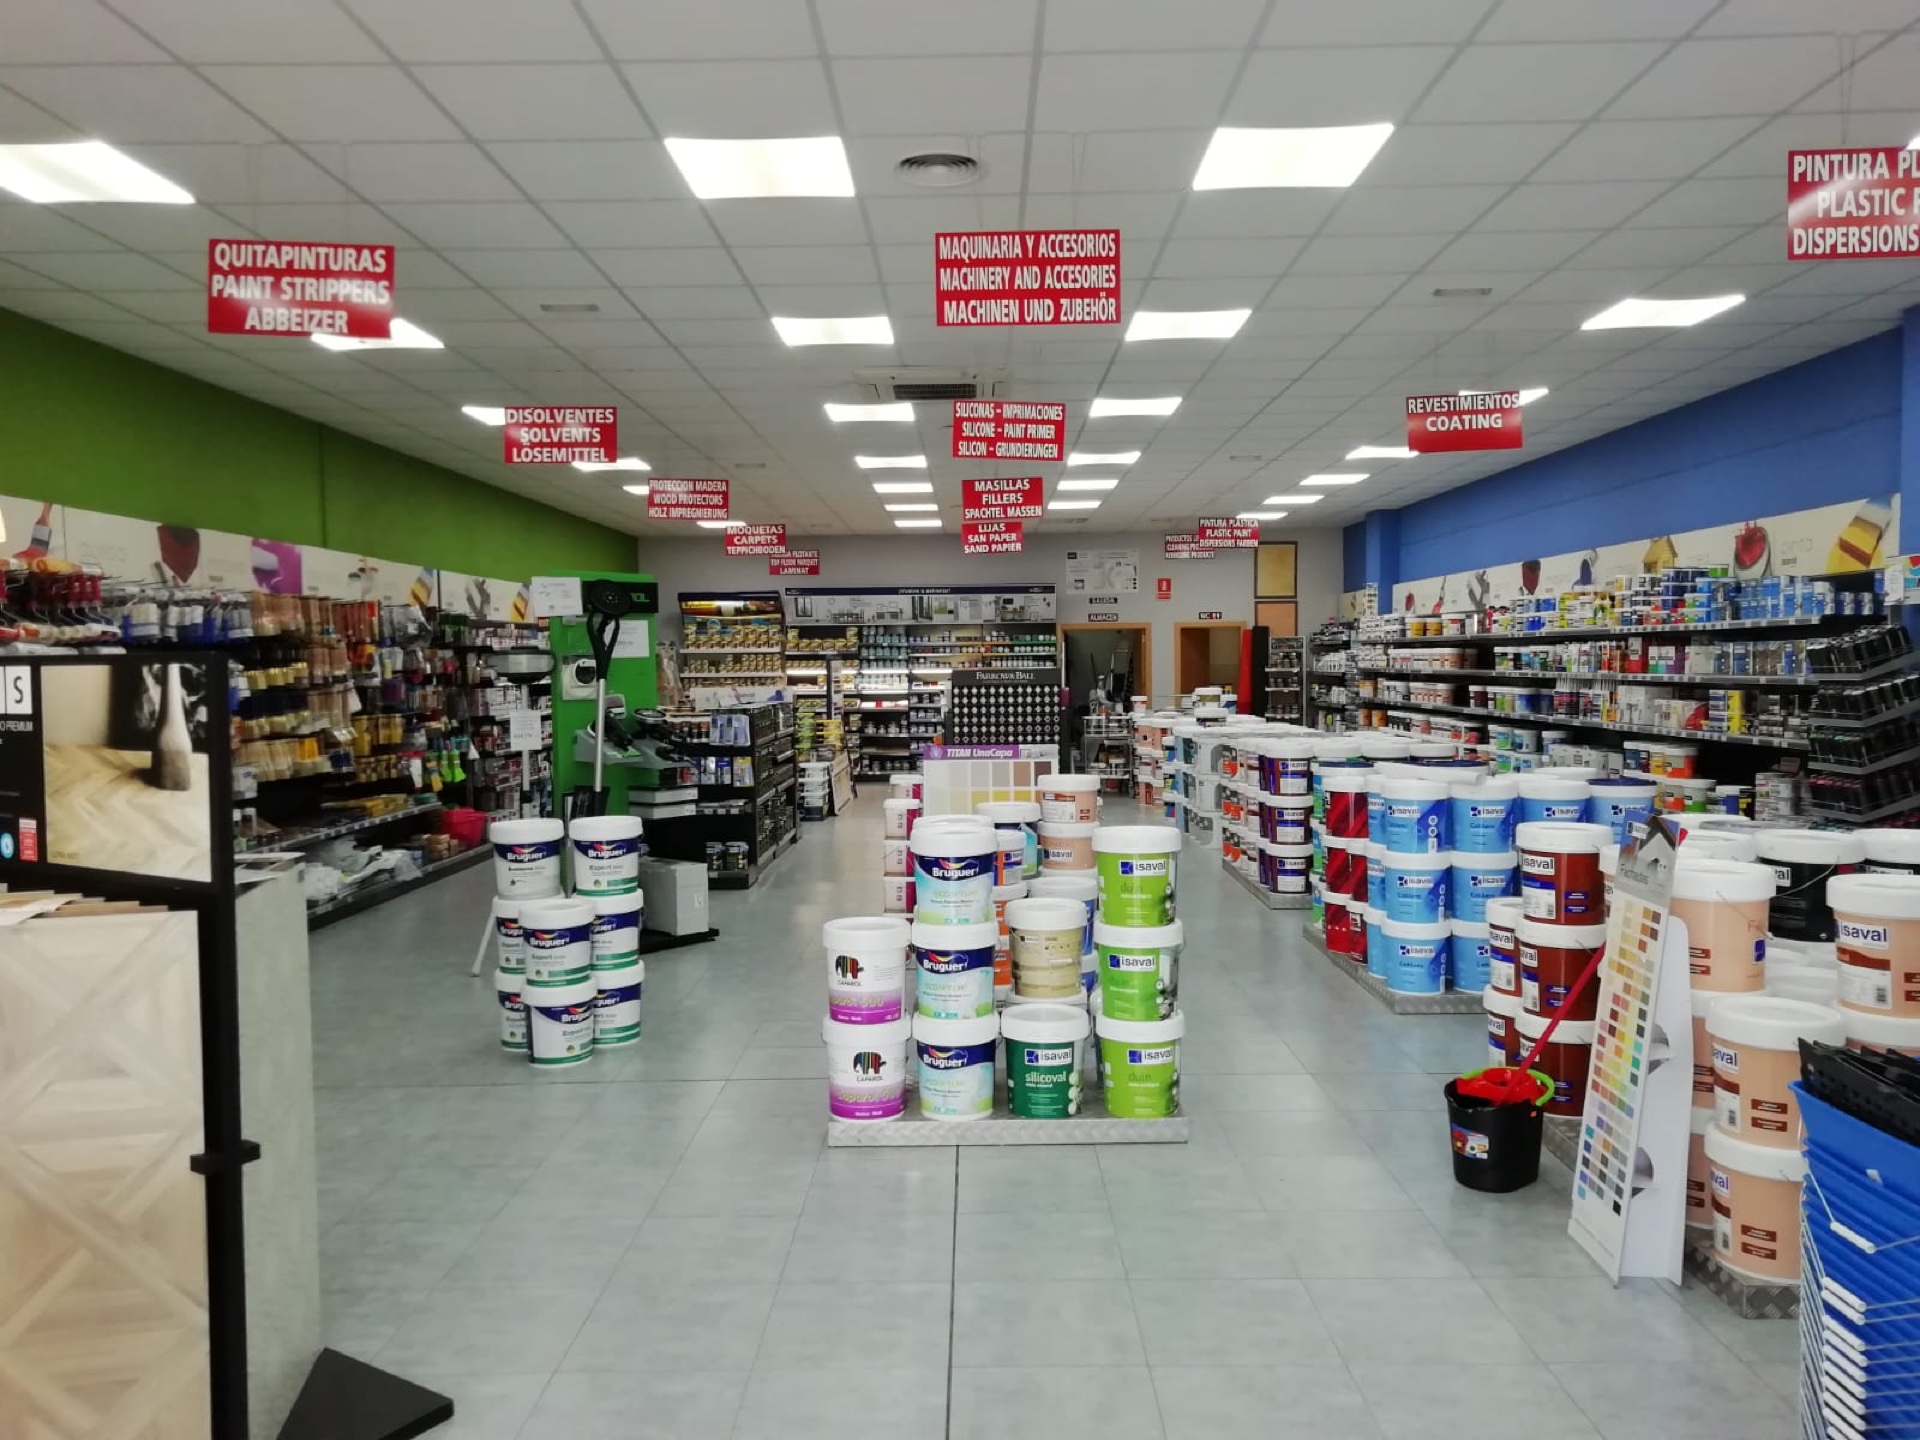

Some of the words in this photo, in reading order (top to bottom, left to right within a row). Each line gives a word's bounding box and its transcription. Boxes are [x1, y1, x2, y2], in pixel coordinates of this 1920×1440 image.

[1793, 152, 1890, 182] PINTURA
[1817, 187, 1907, 218] PLASTIC
[1793, 223, 1920, 255] DISPERSIONS
[939, 235, 1022, 262] MAQUINARIA
[1025, 235, 1035, 258] Y
[1038, 233, 1116, 258] ACCESORIOS
[214, 243, 386, 273] QUITAPINTURAS
[940, 266, 1011, 291] MACHINERY
[1014, 266, 1041, 289] AND
[1044, 264, 1116, 288] ACCESORIES
[211, 274, 275, 300] PAINT
[280, 276, 390, 305] STRIPPERS
[944, 299, 1019, 324] MACHINEN
[1024, 298, 1054, 322] UND
[1060, 291, 1117, 321] ZUBEHÖR
[245, 307, 348, 333] ABBEIZER
[1408, 394, 1519, 414] REVESTIMIENTOS
[506, 408, 614, 424] DISOLVENTES
[955, 402, 995, 417] SILICONAS
[1002, 404, 1063, 420] IMPRIMACIONES
[1426, 413, 1503, 432] COATING
[520, 426, 601, 443] SOLVENTS
[962, 421, 996, 437] SILICONE
[1003, 424, 1025, 438] PAINT
[1027, 424, 1055, 439] PRIMER
[958, 441, 987, 456] SILICON
[695, 481, 727, 492] MADERA
[974, 478, 1030, 491] MASILLAS
[653, 493, 678, 504] WOOD
[678, 494, 723, 505] PROTECTORS
[982, 493, 1023, 505] FILLERS
[648, 506, 668, 517] HOLZ
[669, 507, 728, 518] IMPREGNIERUNG
[965, 507, 1005, 519] SPACHTEL
[1007, 505, 1042, 517] MASSEN
[1199, 518, 1227, 528] PINTURA
[727, 526, 783, 535] MOQUETAS
[1206, 529, 1231, 537] PLASTIC
[1233, 529, 1252, 537] PAINT
[733, 535, 778, 544] CARPETS
[989, 533, 1017, 542] PAPER
[1199, 539, 1235, 547] DISPERSIONS
[964, 544, 989, 554] SAND
[991, 543, 1022, 552] PAPIER
[6, 720, 34, 732] PREMIUM
[507, 851, 543, 862] Bruguer
[587, 849, 624, 859] Bruguer
[1135, 860, 1166, 871] isaval
[931, 867, 975, 878] Bruguer
[1840, 921, 1887, 942] isaval
[529, 937, 567, 948] Bruguer
[923, 959, 963, 973] Bruguer
[1121, 955, 1155, 966] isaval
[923, 1054, 963, 1068] Bruguer
[1041, 1049, 1071, 1061] isaval
[1025, 1071, 1067, 1083] silicoval
